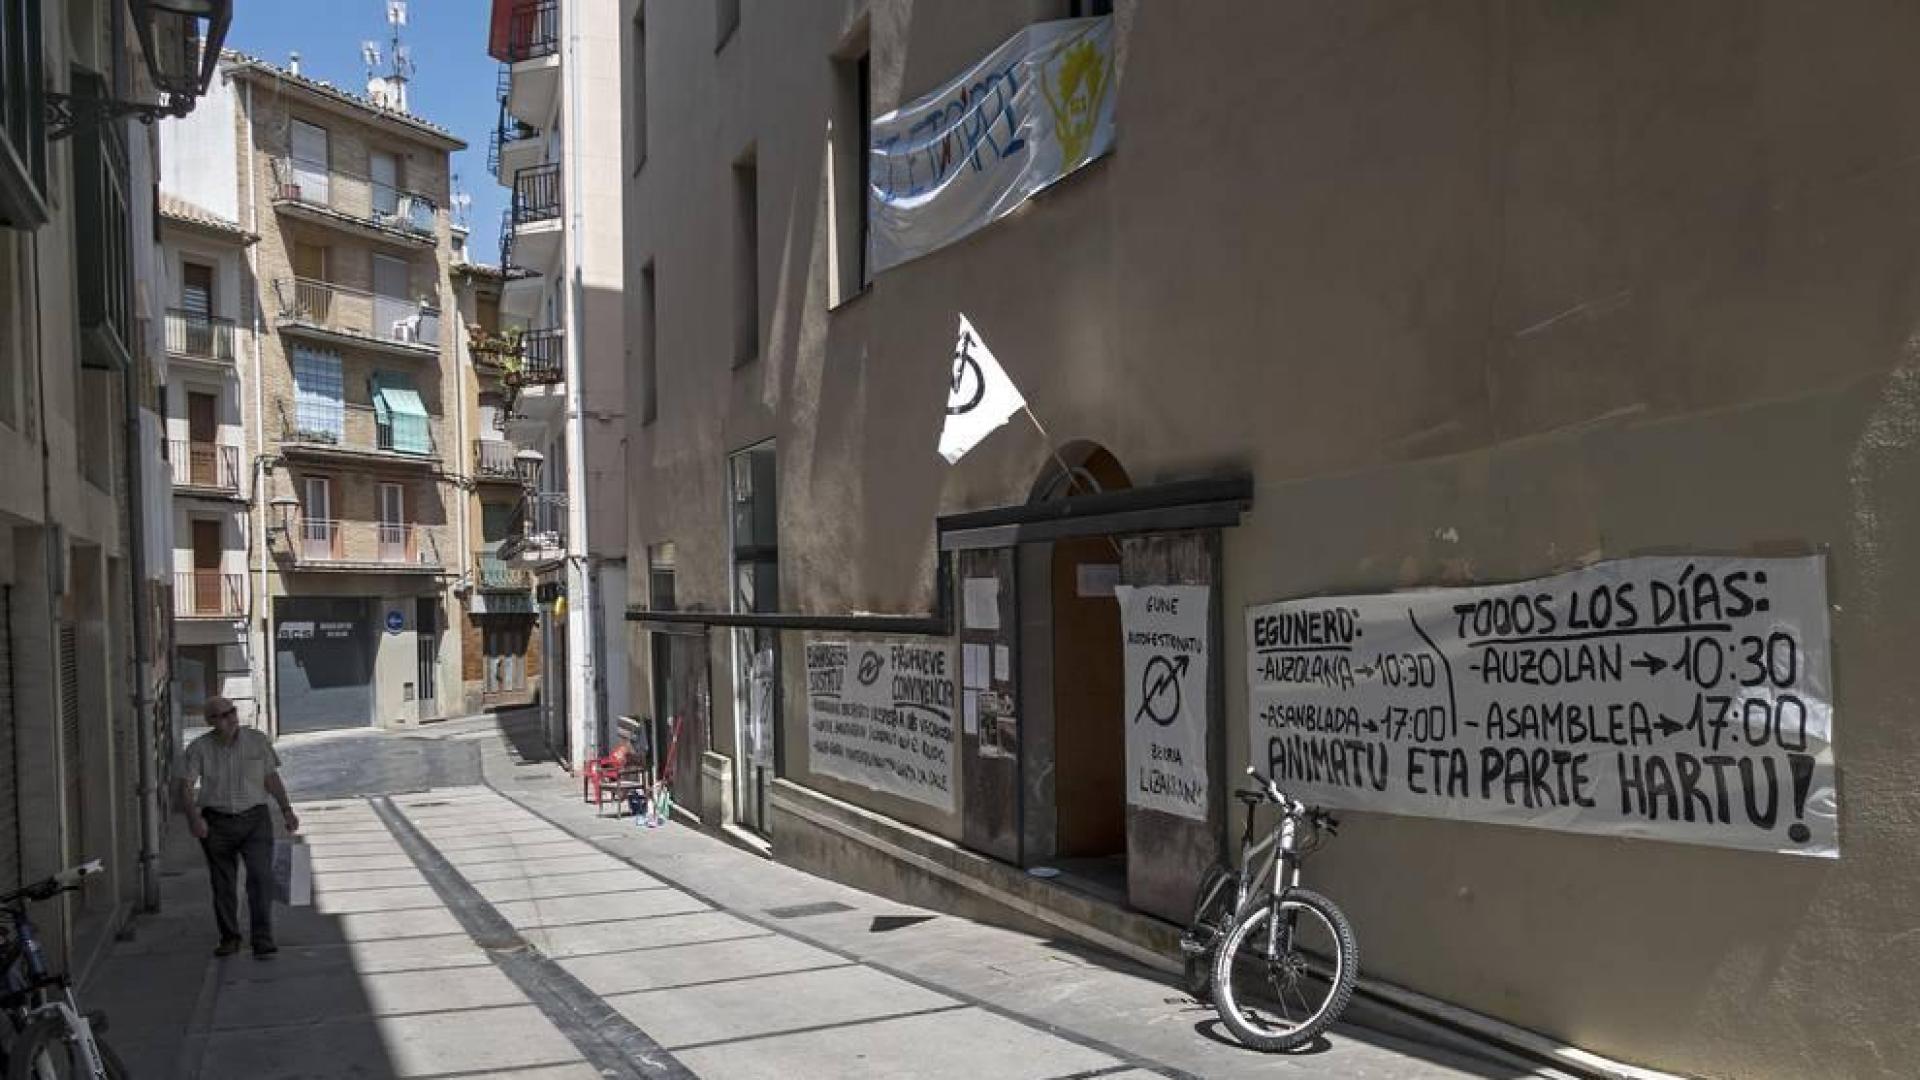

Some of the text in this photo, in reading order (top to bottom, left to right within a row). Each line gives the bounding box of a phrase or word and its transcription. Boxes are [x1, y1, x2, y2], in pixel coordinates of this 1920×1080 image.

[1453, 563, 1770, 638] TODOS LOS DÍAS:
[1375, 652, 1436, 688] 10:30
[1672, 632, 1797, 689] 10:30
[1381, 704, 1446, 744] 17:00
[1686, 692, 1807, 752] 17:00
[1269, 735, 1816, 843] ANIMATU ETA PARTE HARTU!
